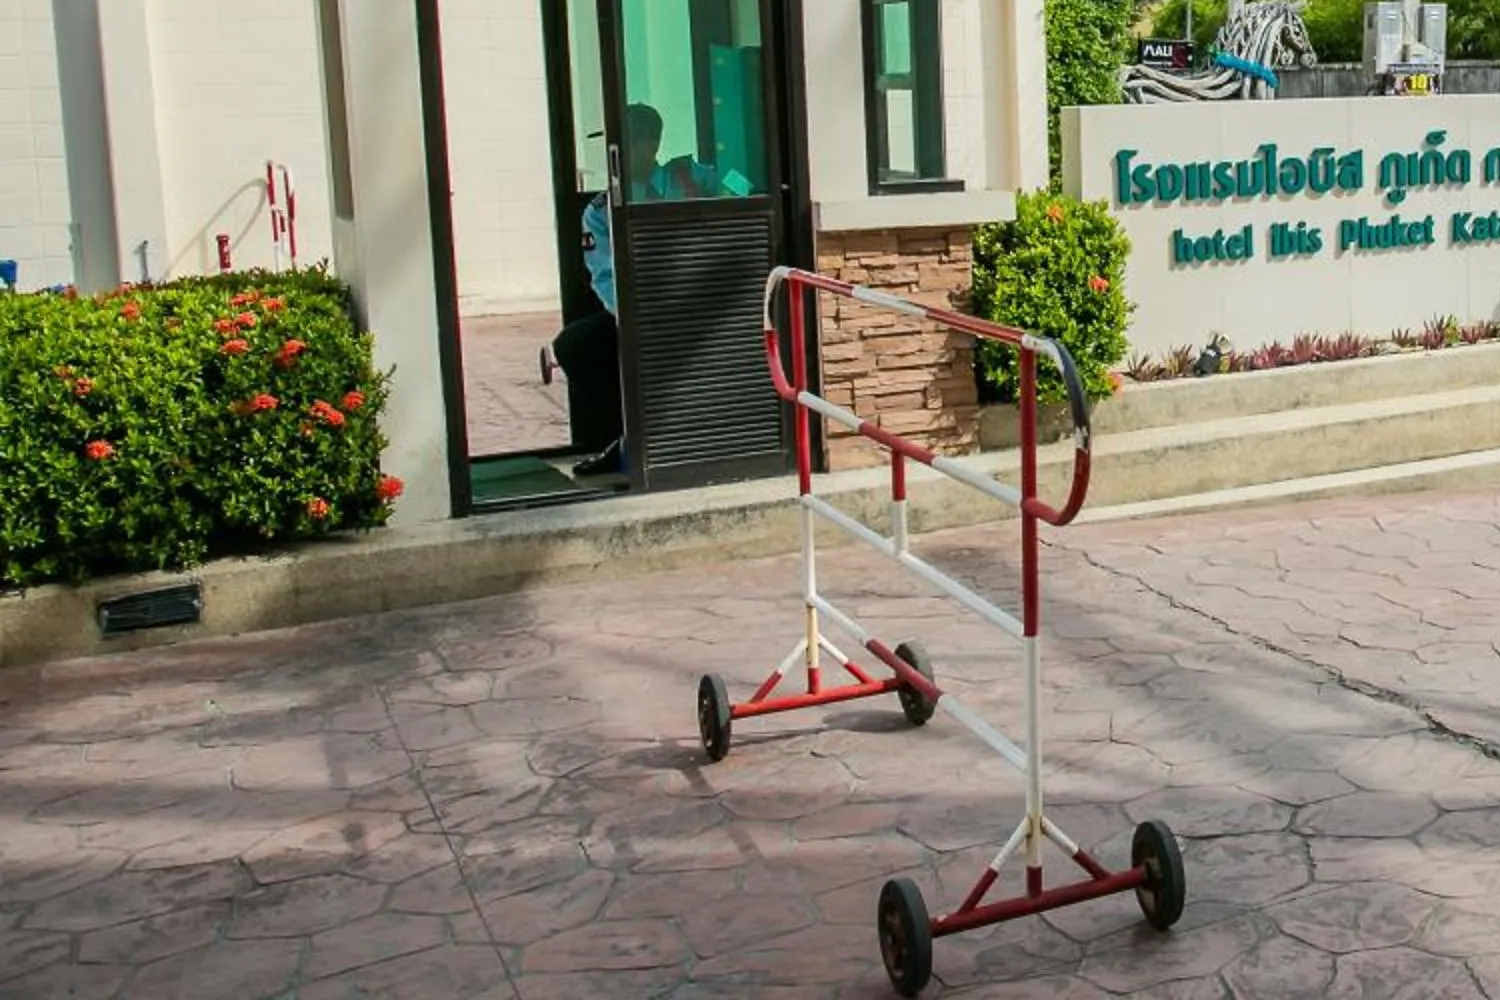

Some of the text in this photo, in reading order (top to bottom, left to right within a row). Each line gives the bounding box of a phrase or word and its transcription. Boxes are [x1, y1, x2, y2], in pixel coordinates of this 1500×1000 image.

[1379, 130, 1471, 205] ภูเก็ต
[1172, 223, 1253, 264] hotel
[1340, 213, 1435, 251] Phuket
